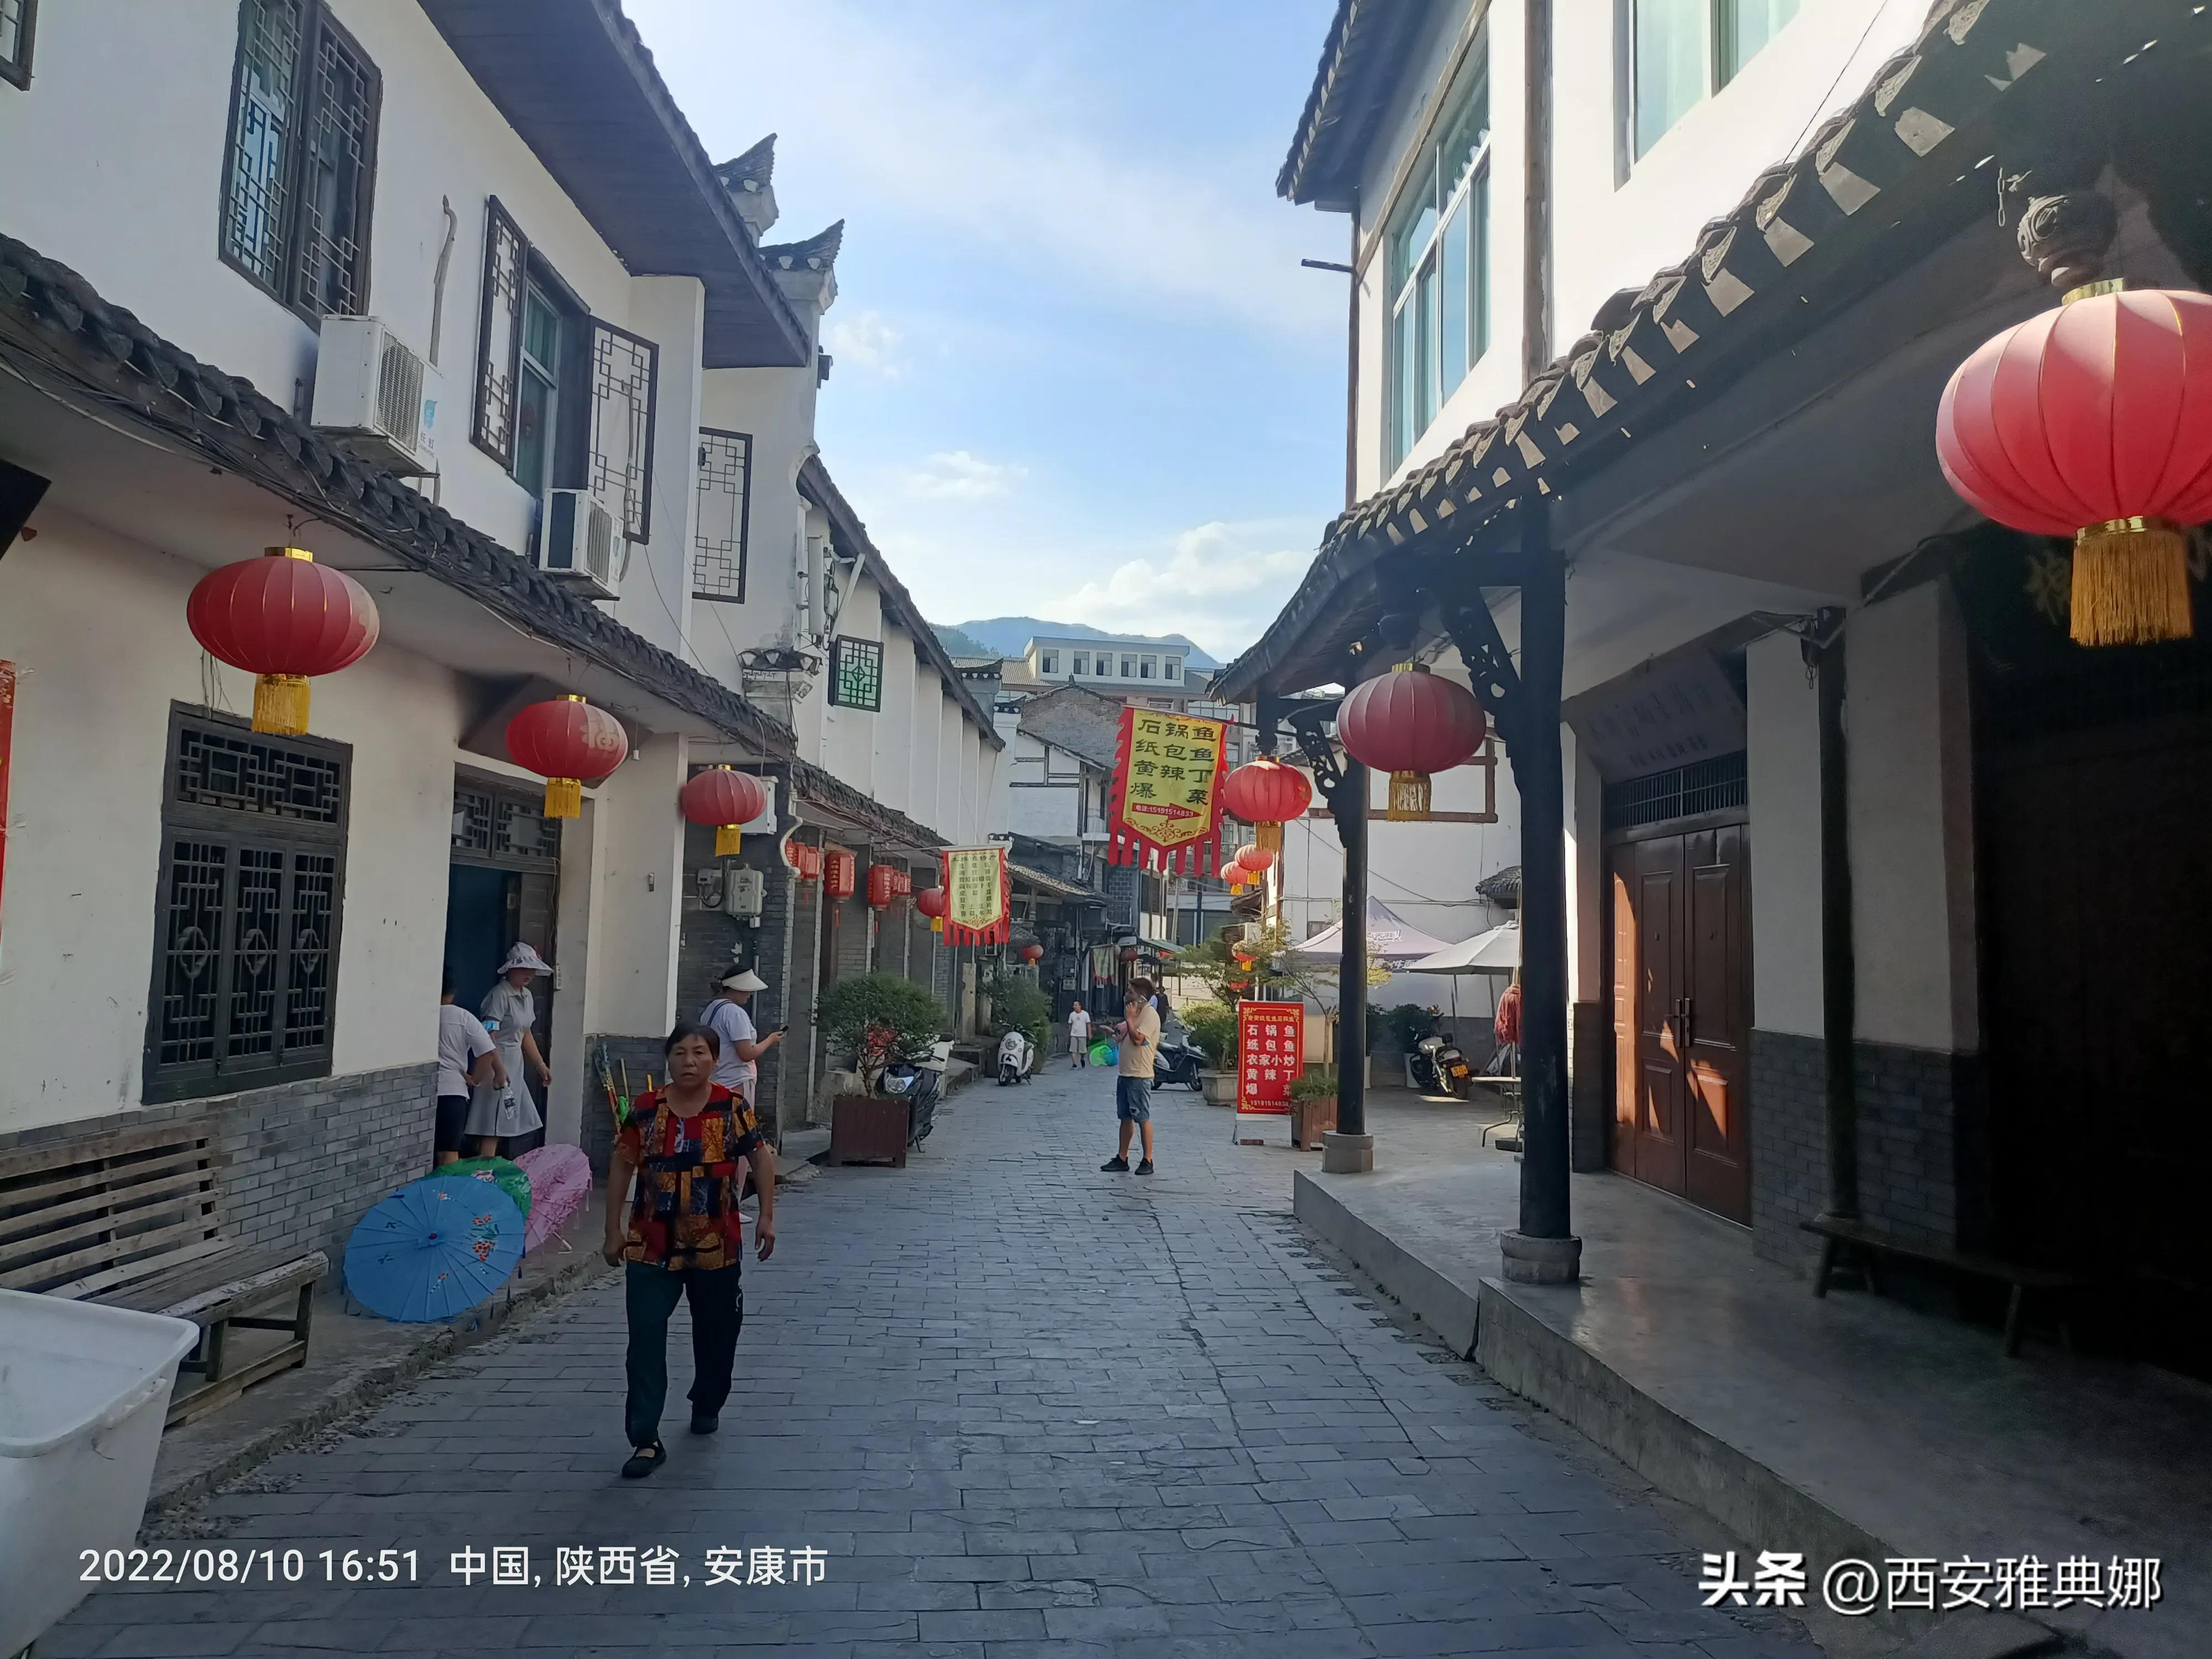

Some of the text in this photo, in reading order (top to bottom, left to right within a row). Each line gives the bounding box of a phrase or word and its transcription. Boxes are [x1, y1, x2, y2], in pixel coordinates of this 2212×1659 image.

[1138, 719, 1217, 742] 石锅鱼
[1135, 738, 1215, 762] 纸包鱼
[1134, 760, 1213, 783] 黄辣丁
[1247, 1024, 1296, 1037] 石锅鱼
[1246, 1039, 1295, 1052] 纸包鱼
[1246, 1054, 1295, 1066] 农家小炒
[1246, 1068, 1295, 1081] 黄辣丁
